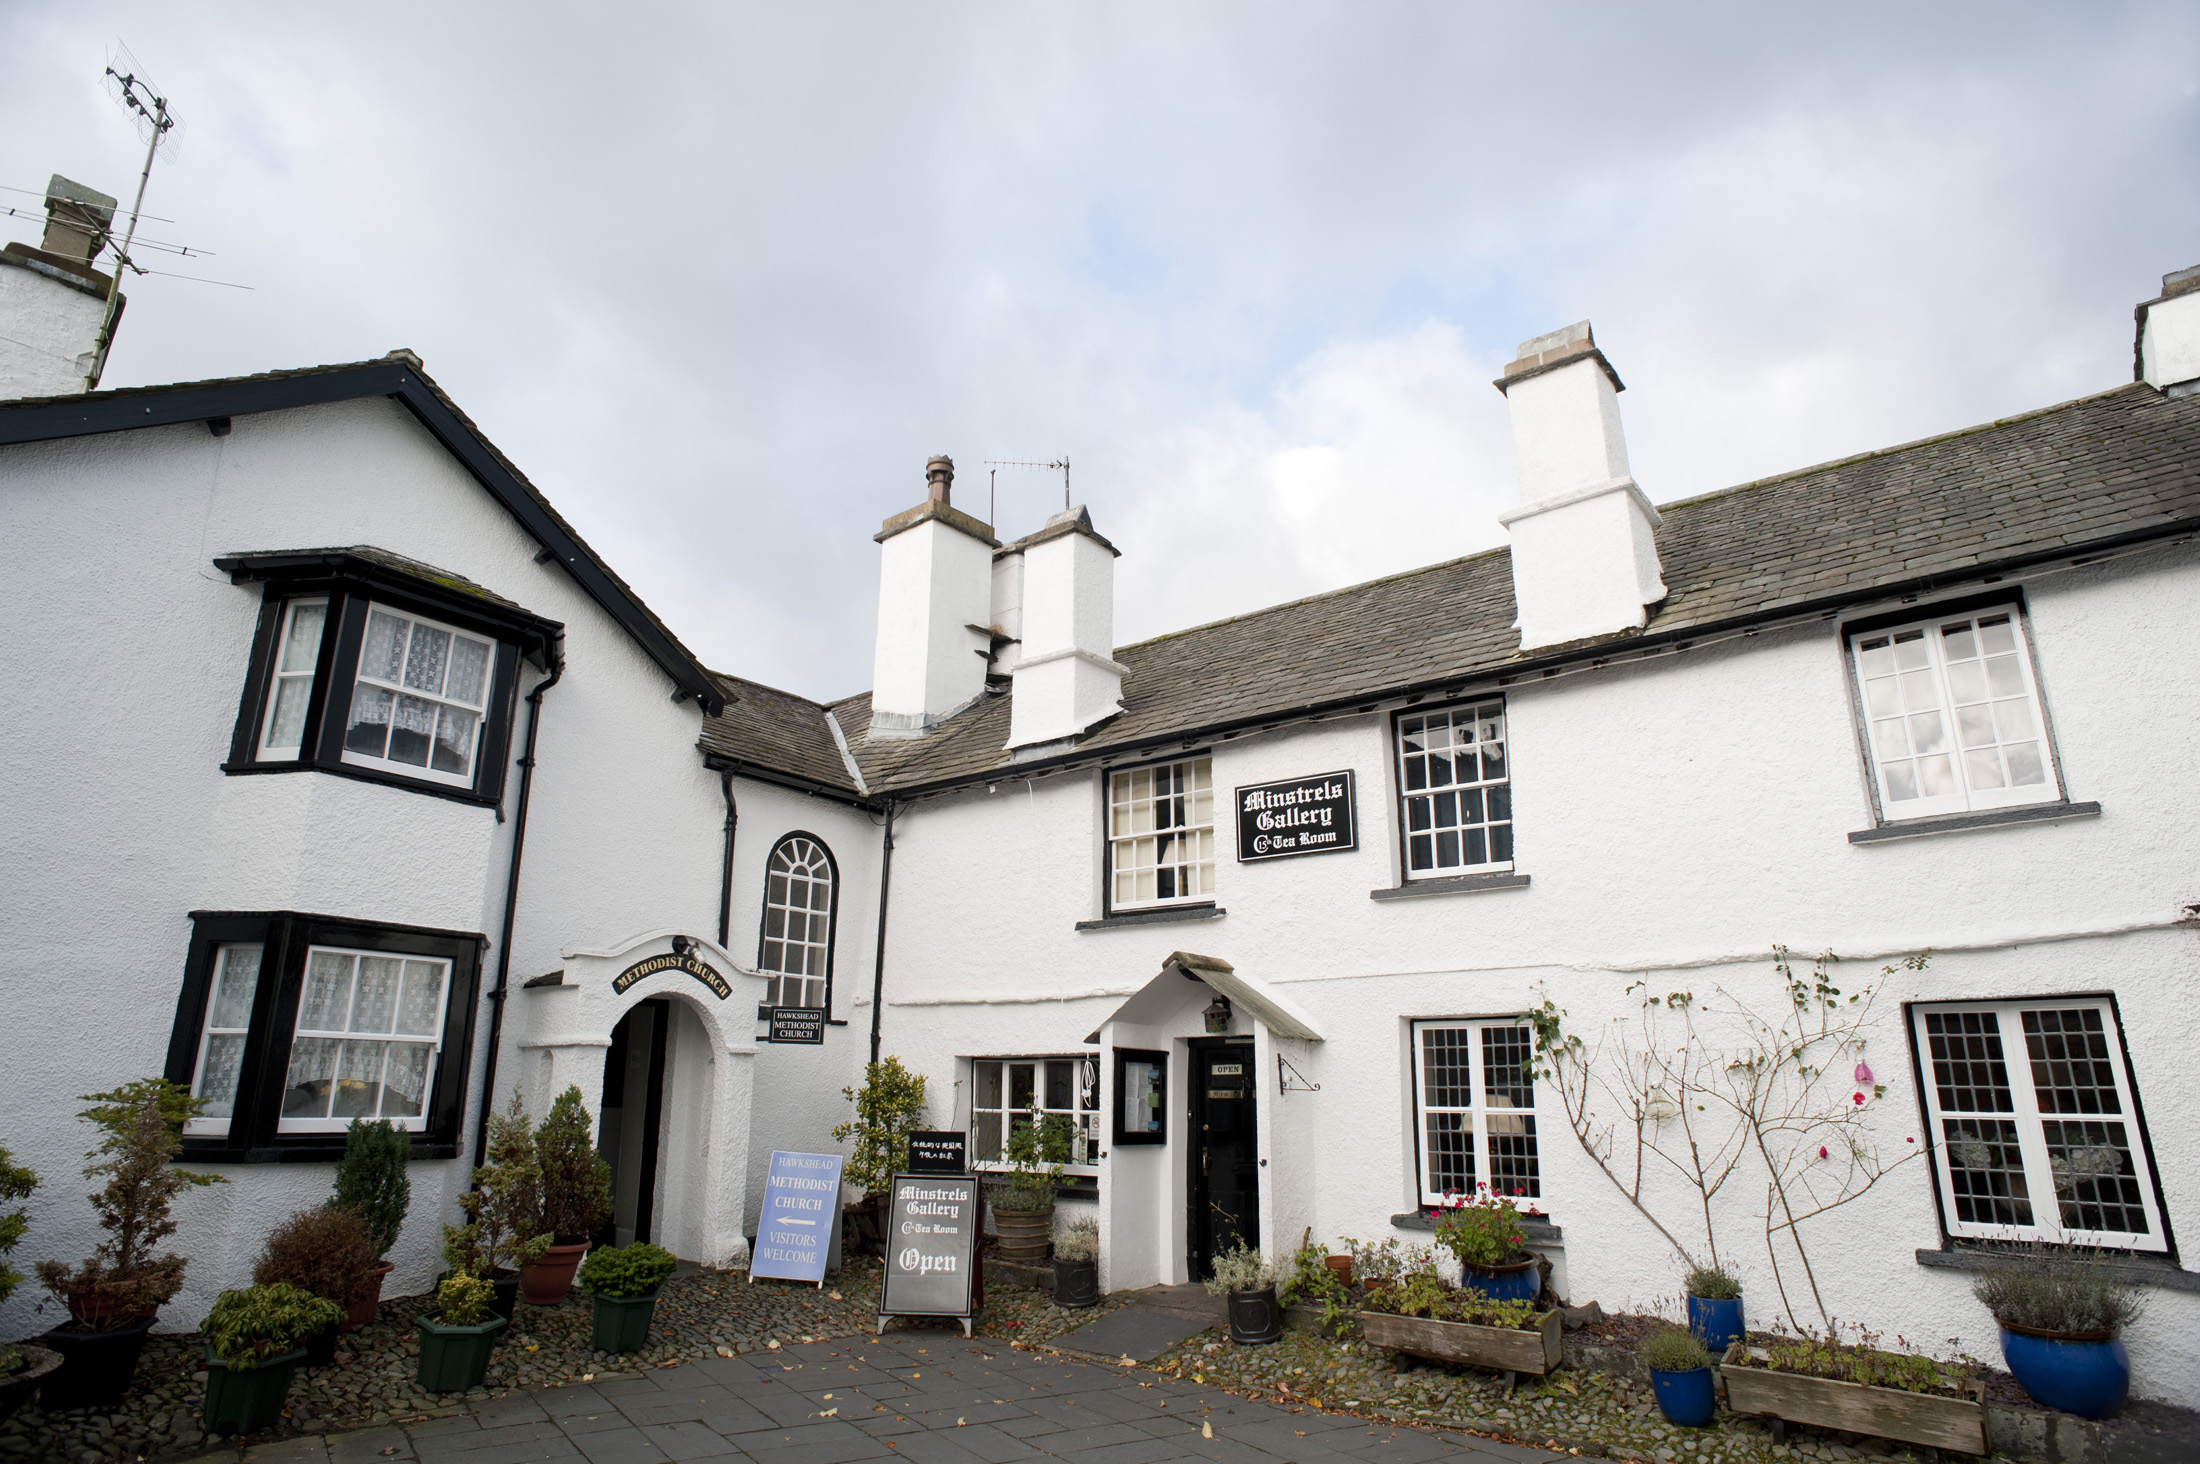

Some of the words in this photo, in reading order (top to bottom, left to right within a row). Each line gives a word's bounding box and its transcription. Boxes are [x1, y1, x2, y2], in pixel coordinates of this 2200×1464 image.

[1244, 781, 1343, 812] Minstrels
[1256, 807, 1333, 831] Gallery
[1272, 836, 1296, 849] Tea
[1299, 831, 1337, 846] Room
[616, 956, 684, 990] METHODIST
[686, 960, 729, 997] CHURCH
[776, 1012, 819, 1020] HAWKSHEAD
[774, 1020, 820, 1030] METHODIST
[779, 1029, 813, 1039] CHURCH
[1217, 1065, 1240, 1073] OPEN
[778, 1157, 833, 1169] HAWKSHEAD
[770, 1176, 835, 1191] METHODIST
[899, 1186, 968, 1201] Minstrels
[775, 1196, 822, 1211] CHURCH
[906, 1201, 959, 1219] Gallery
[915, 1224, 931, 1234] Tea
[933, 1224, 958, 1234] Room
[770, 1231, 817, 1247] VISITORS
[763, 1247, 817, 1264] WELCOME
[899, 1247, 957, 1276] Open
